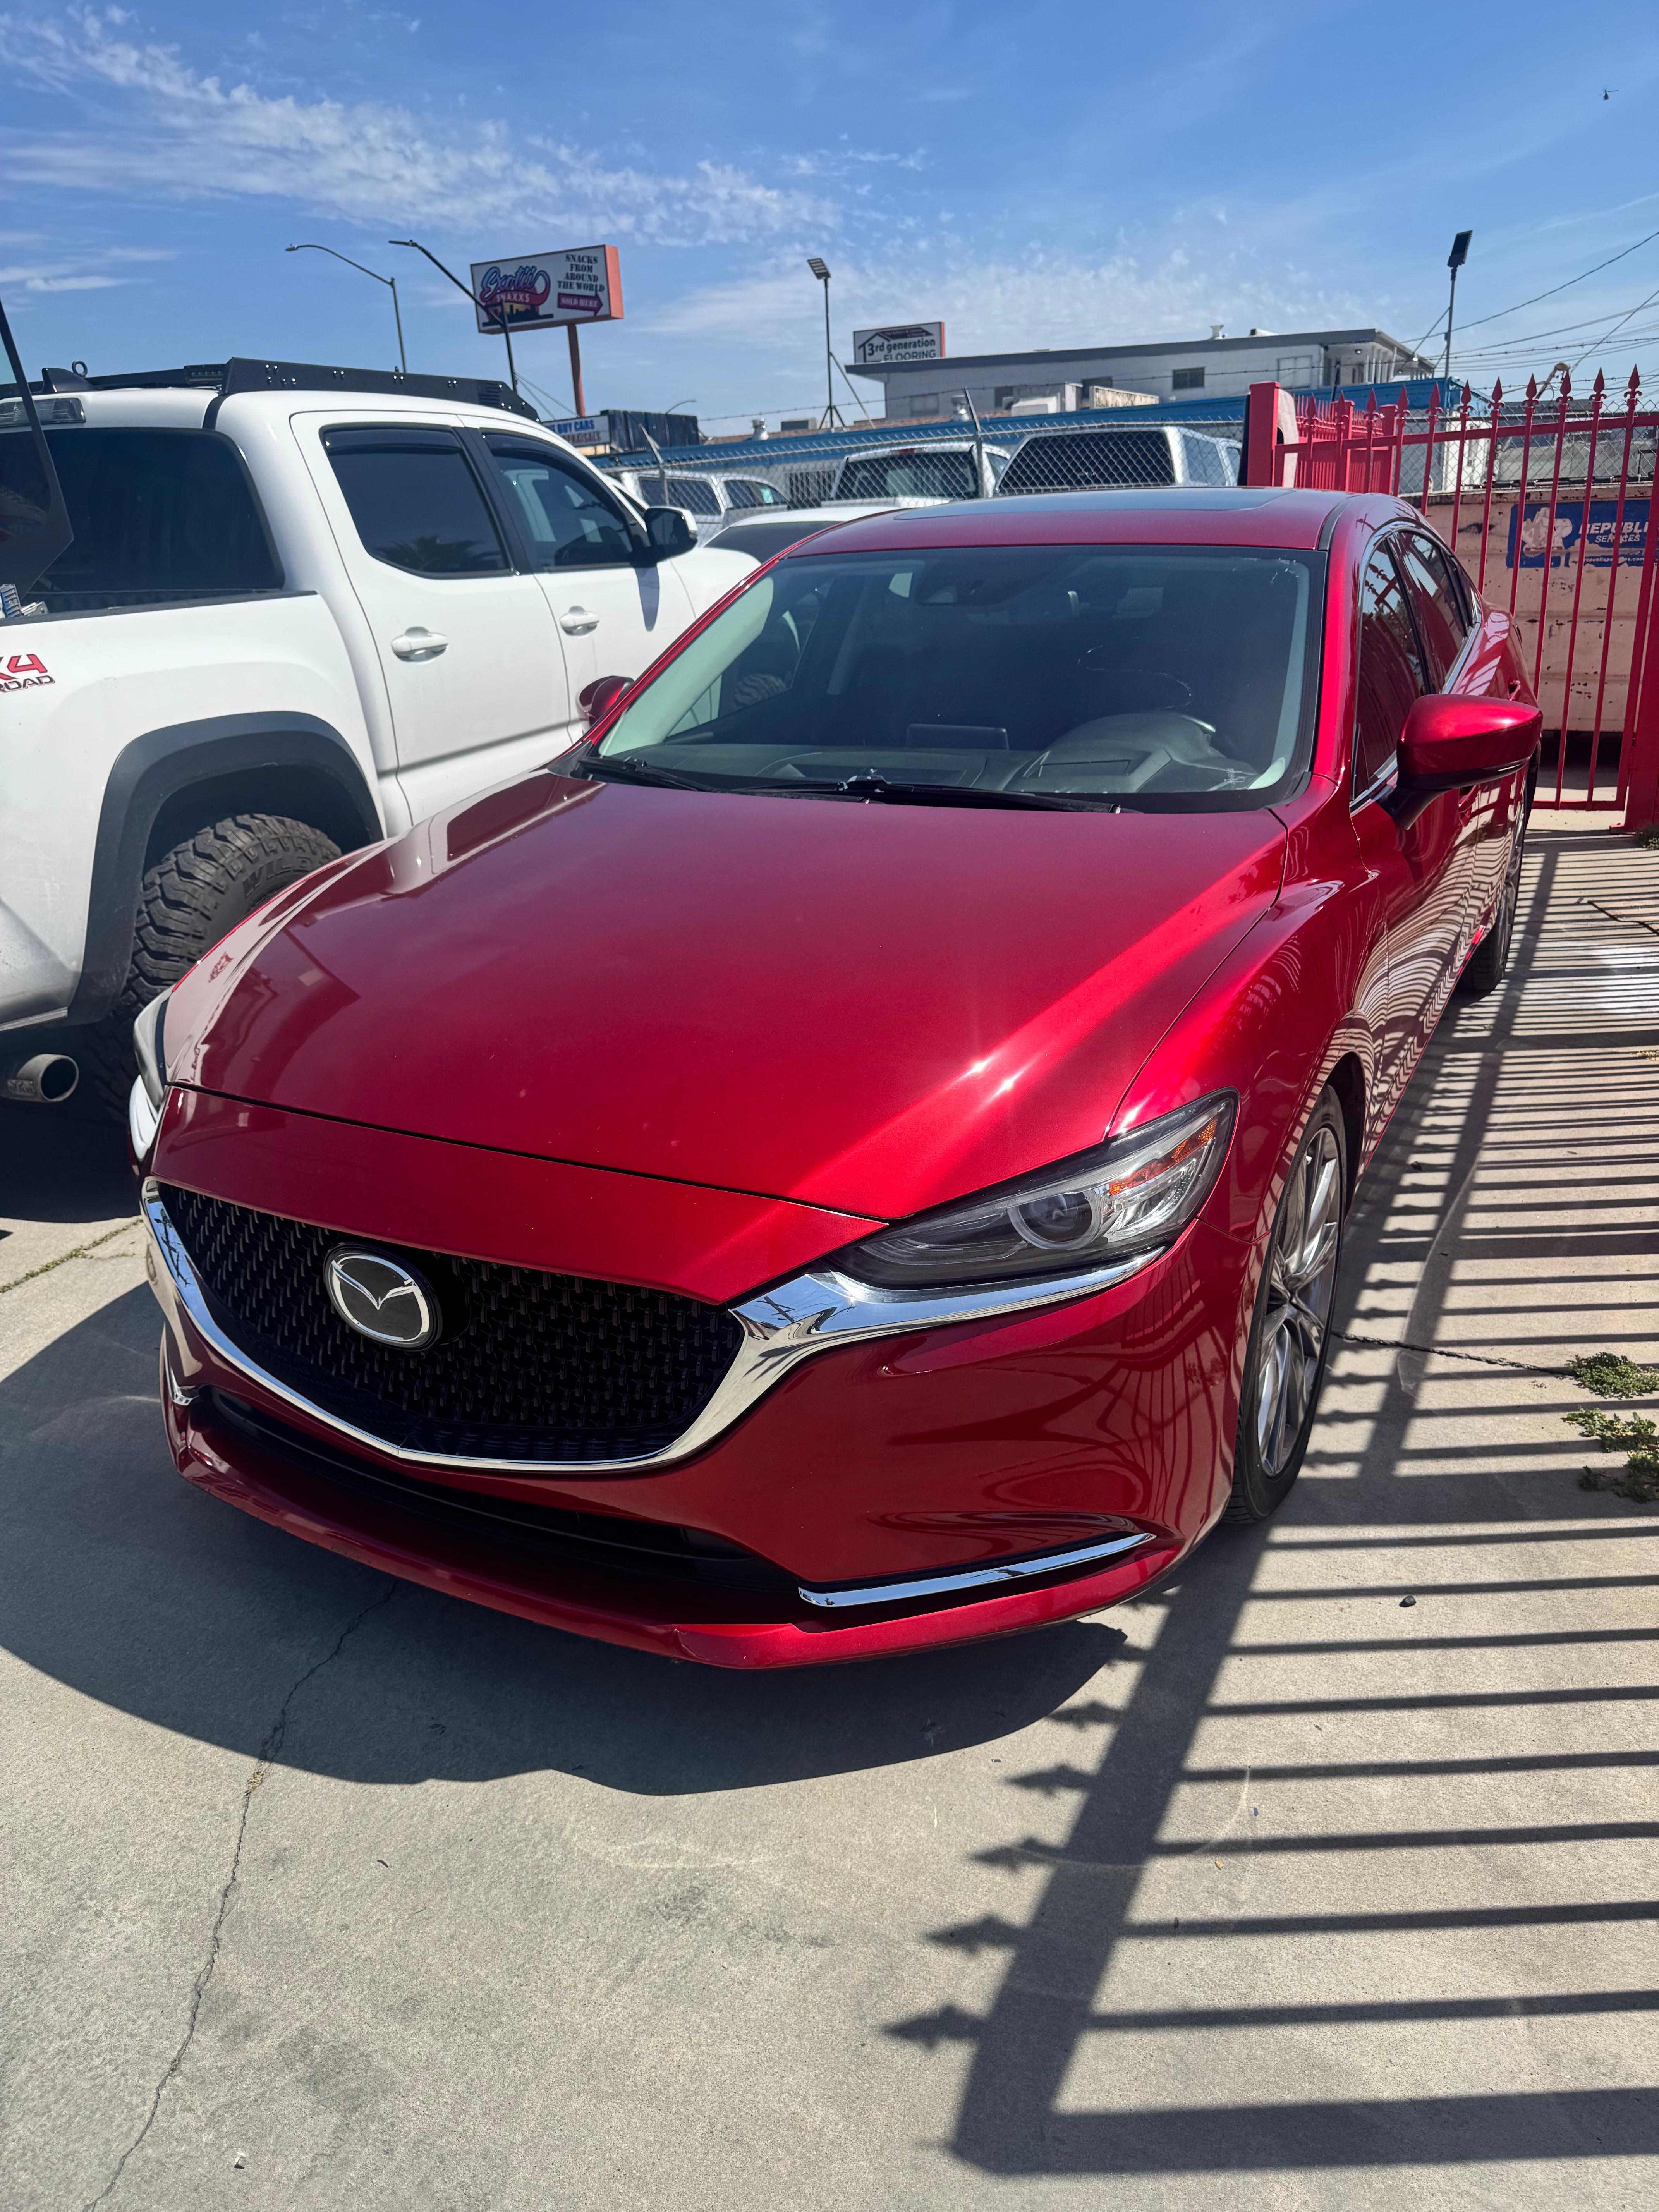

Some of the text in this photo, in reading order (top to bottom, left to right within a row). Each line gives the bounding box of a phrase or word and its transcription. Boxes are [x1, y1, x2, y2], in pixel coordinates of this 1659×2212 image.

[565, 254, 598, 264] SNACKS
[570, 264, 593, 272] FROM
[564, 272, 598, 282] AROUND
[558, 280, 605, 292] THE WORLD
[496, 293, 530, 303] SNAXXS
[867, 338, 936, 356] 3rd generation
[884, 350, 936, 361] FLOORING
[574, 419, 595, 431] CARS
